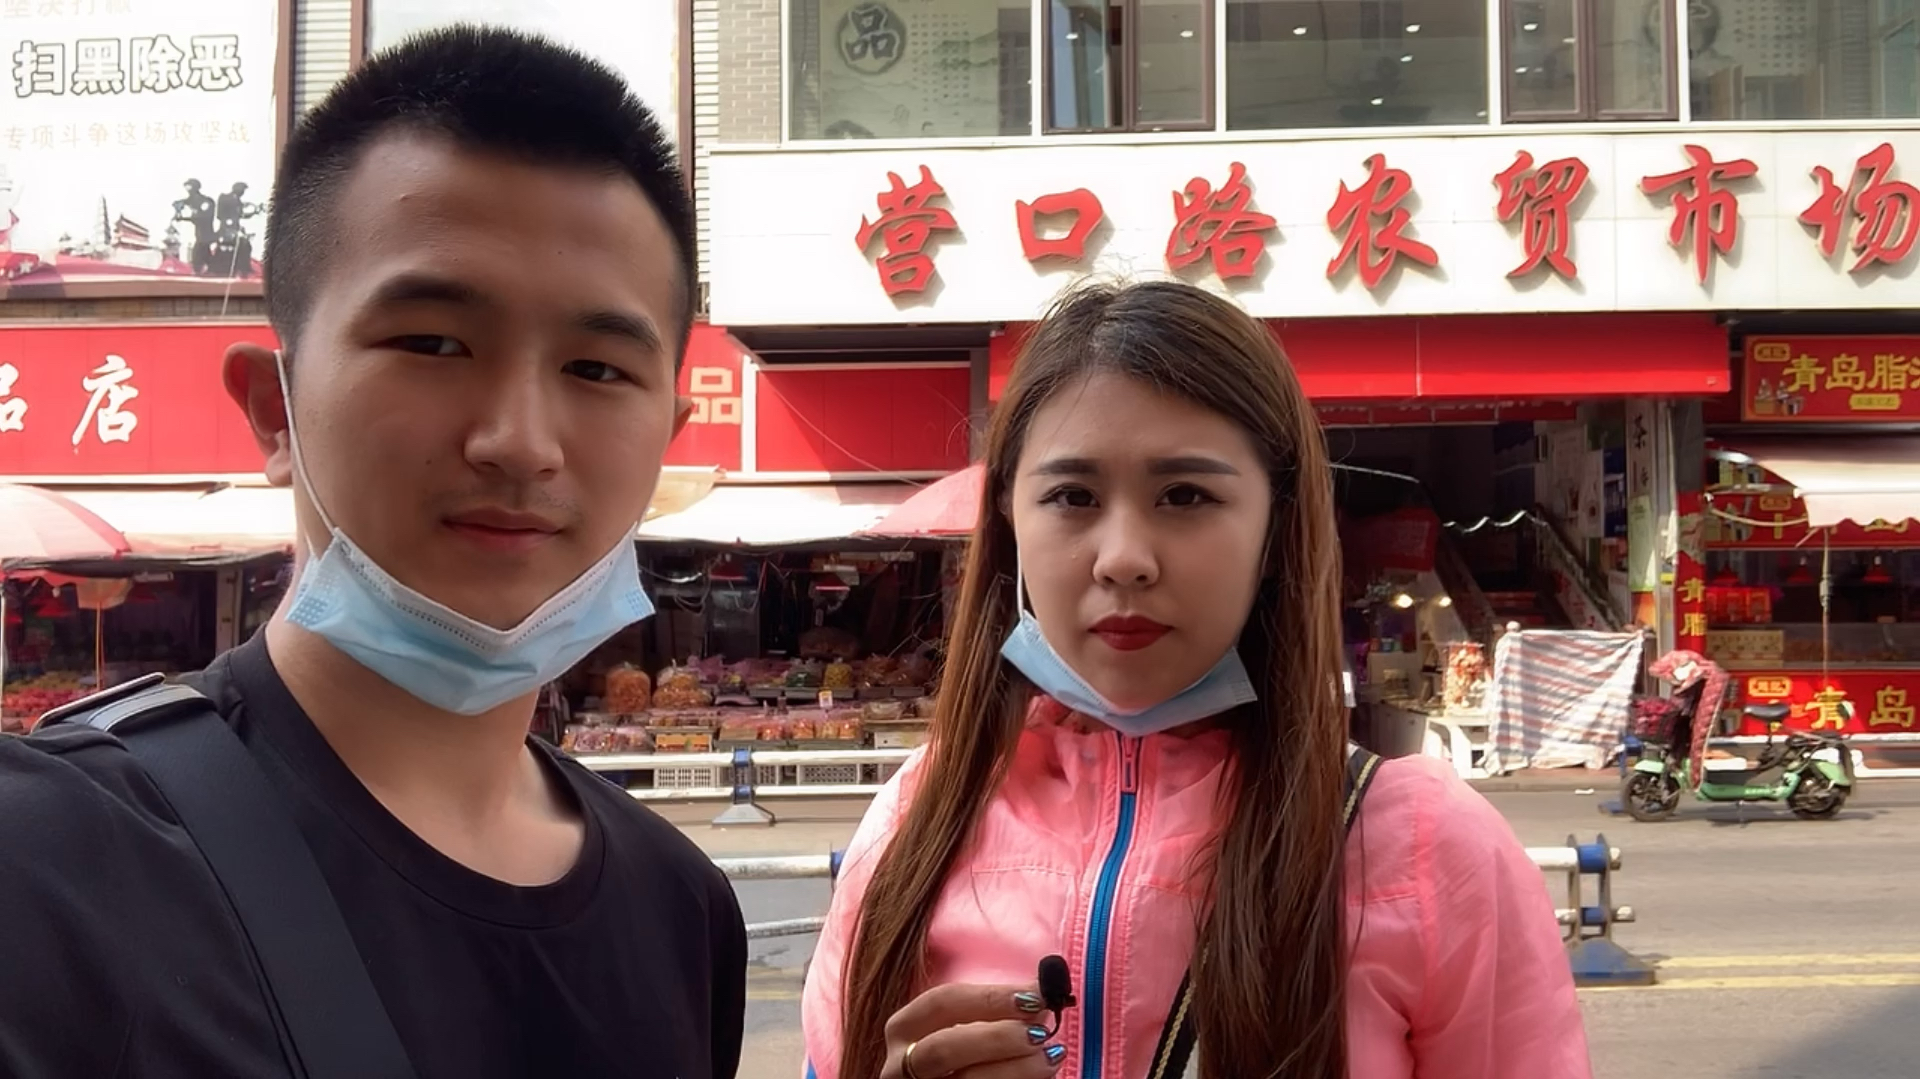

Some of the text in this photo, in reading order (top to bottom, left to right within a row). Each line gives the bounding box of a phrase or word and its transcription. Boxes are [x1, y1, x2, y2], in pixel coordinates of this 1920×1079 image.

[13, 34, 243, 97] 扫黑除恶
[4, 121, 250, 150] 专项斗争这场攻坚战
[855, 143, 1920, 297] 营口路农贸市场
